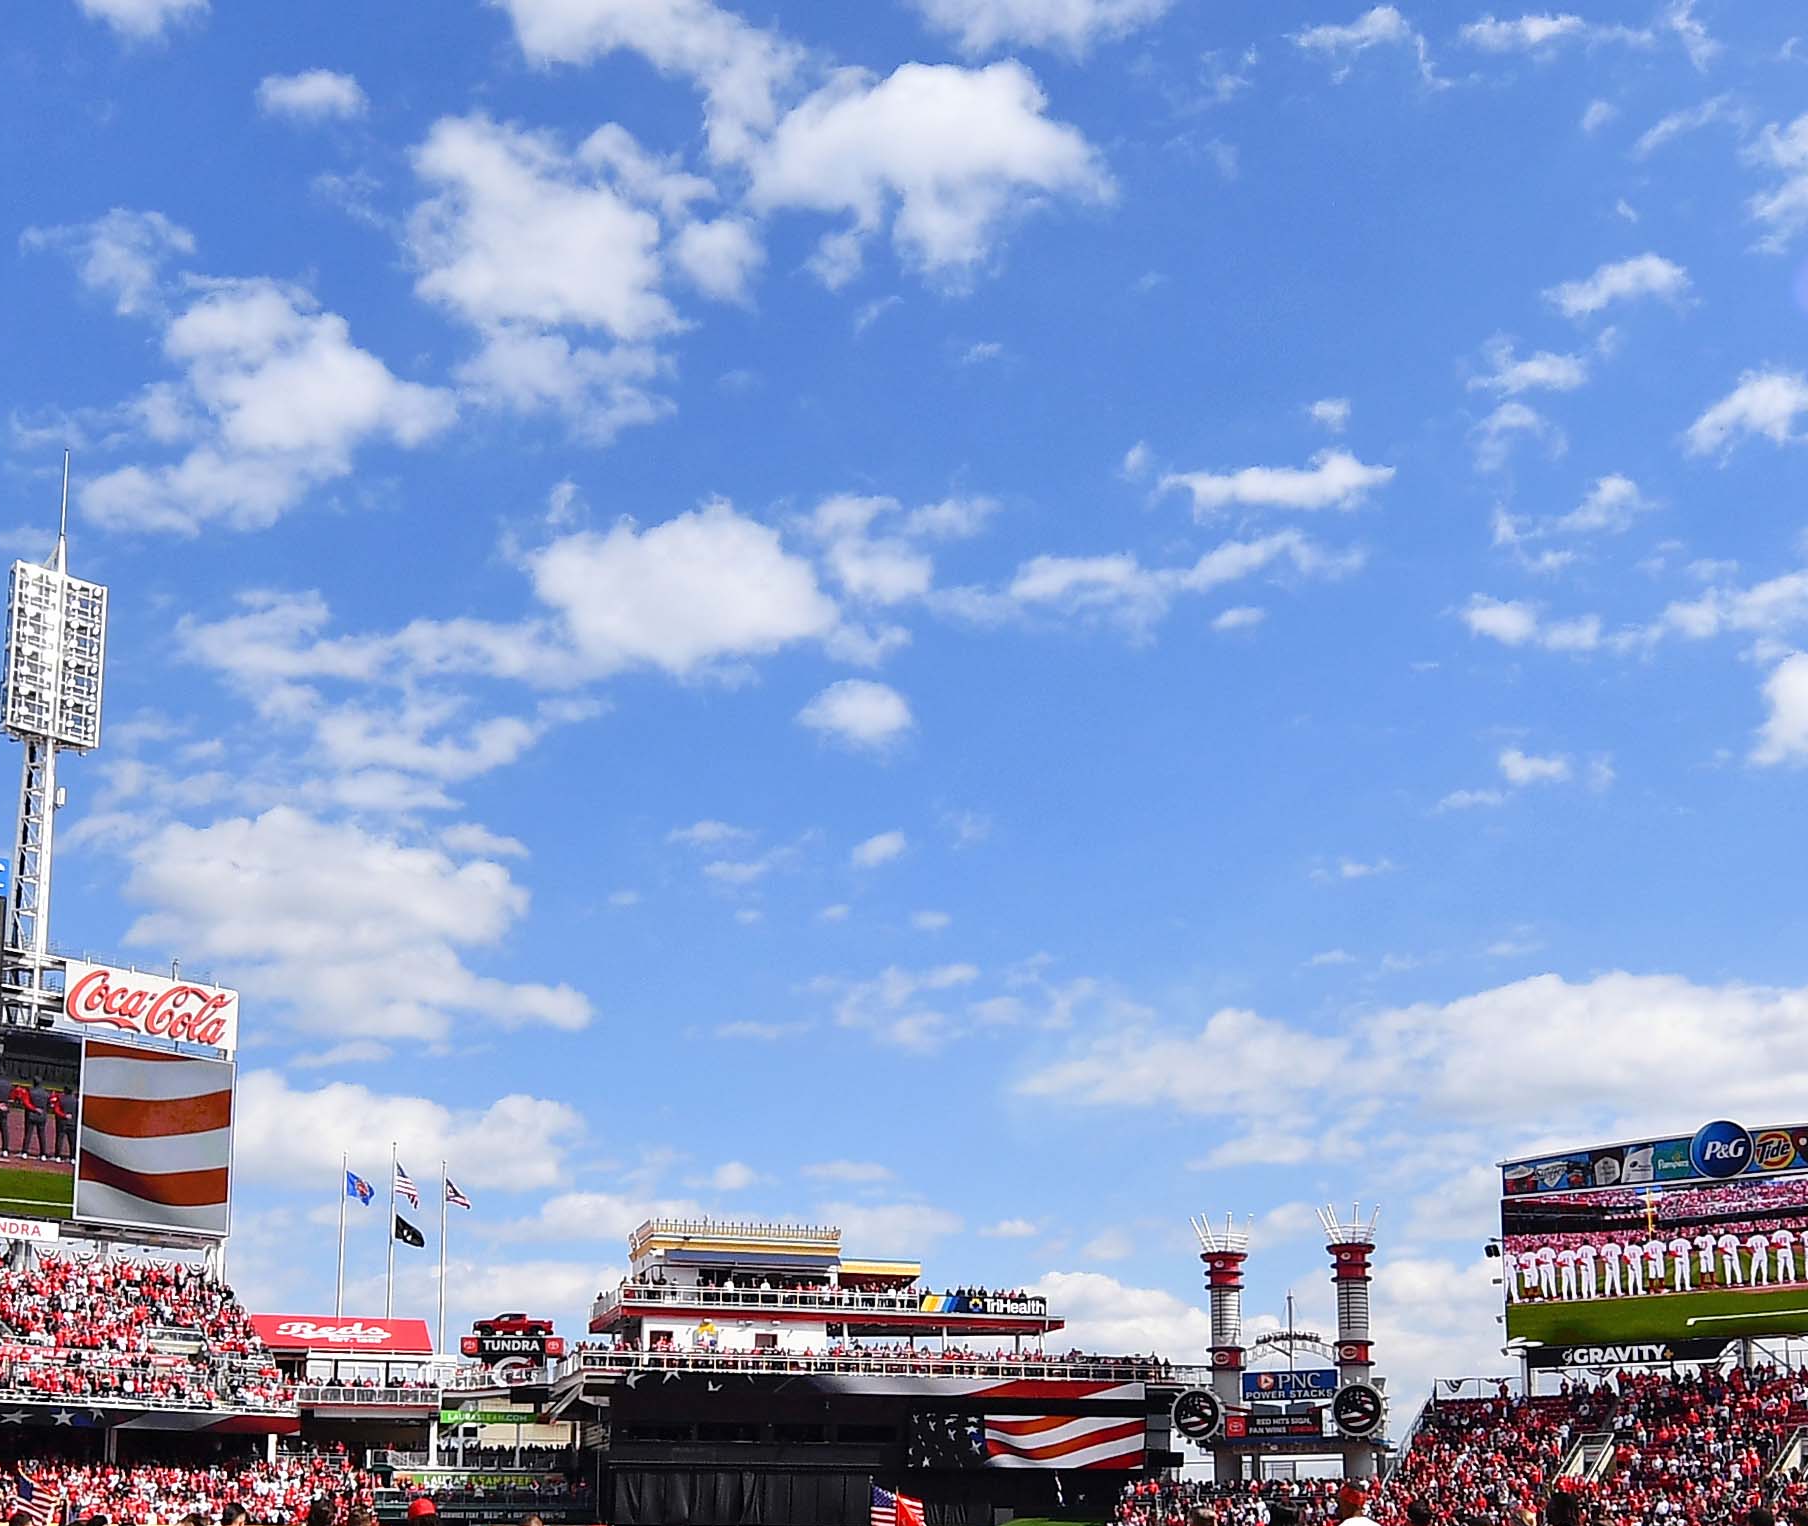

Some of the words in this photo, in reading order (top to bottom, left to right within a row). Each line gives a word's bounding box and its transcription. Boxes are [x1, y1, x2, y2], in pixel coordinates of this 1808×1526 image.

[66, 969, 235, 1046] Coca-Cola
[1703, 1138, 1746, 1161] P&G
[1756, 1139, 1791, 1164] Tide
[984, 1298, 1046, 1315] TriHealth
[276, 1322, 392, 1340] Reds
[483, 1340, 540, 1351] TUNDRA
[1277, 1372, 1321, 1389] PNC
[1246, 1390, 1286, 1400] POWER
[1289, 1388, 1334, 1399] STACKS
